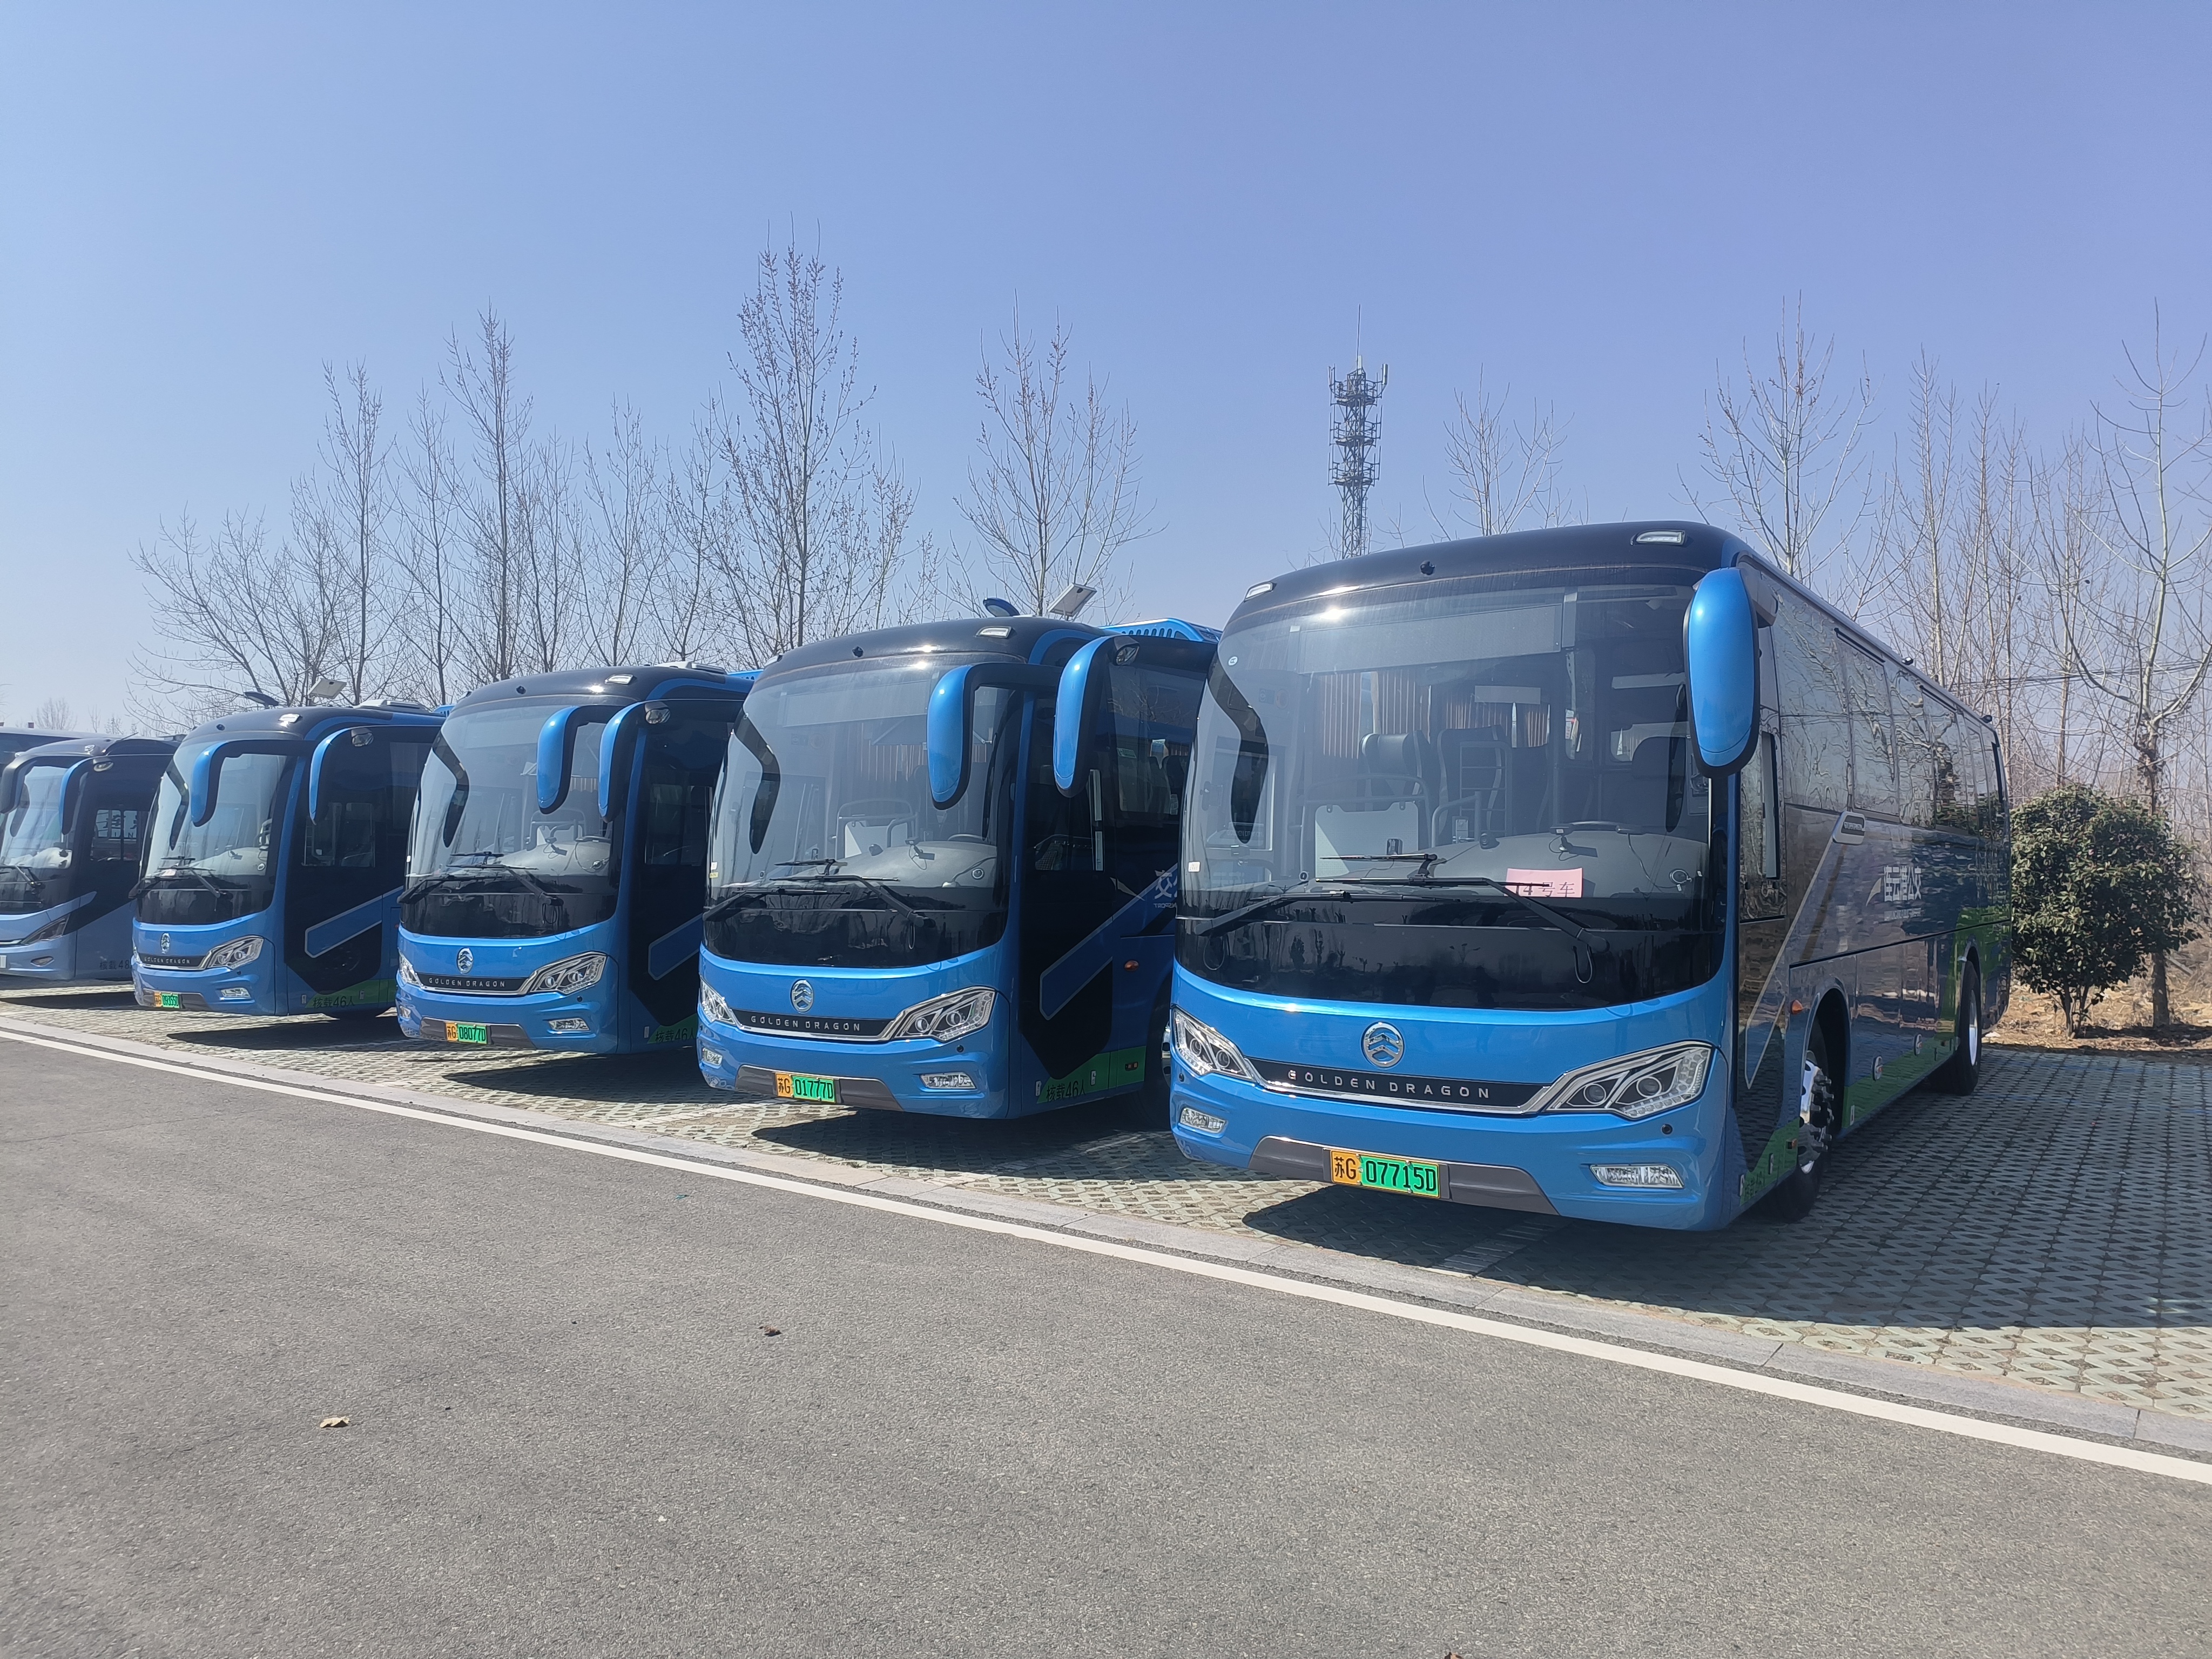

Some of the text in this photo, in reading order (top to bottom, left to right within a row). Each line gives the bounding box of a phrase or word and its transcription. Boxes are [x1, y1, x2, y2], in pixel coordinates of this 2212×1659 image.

[1515, 881, 1575, 898] 14号车
[99, 960, 132, 970] 核载48
[429, 977, 462, 986] GOLDEN
[313, 996, 355, 1008] 核载46人
[751, 1015, 860, 1031] GOLDEN DRAGON
[655, 1028, 695, 1043] 核载46人
[1046, 1079, 1087, 1102] 核载46人
[1287, 1070, 1489, 1099] GOLDEN DRAGON
